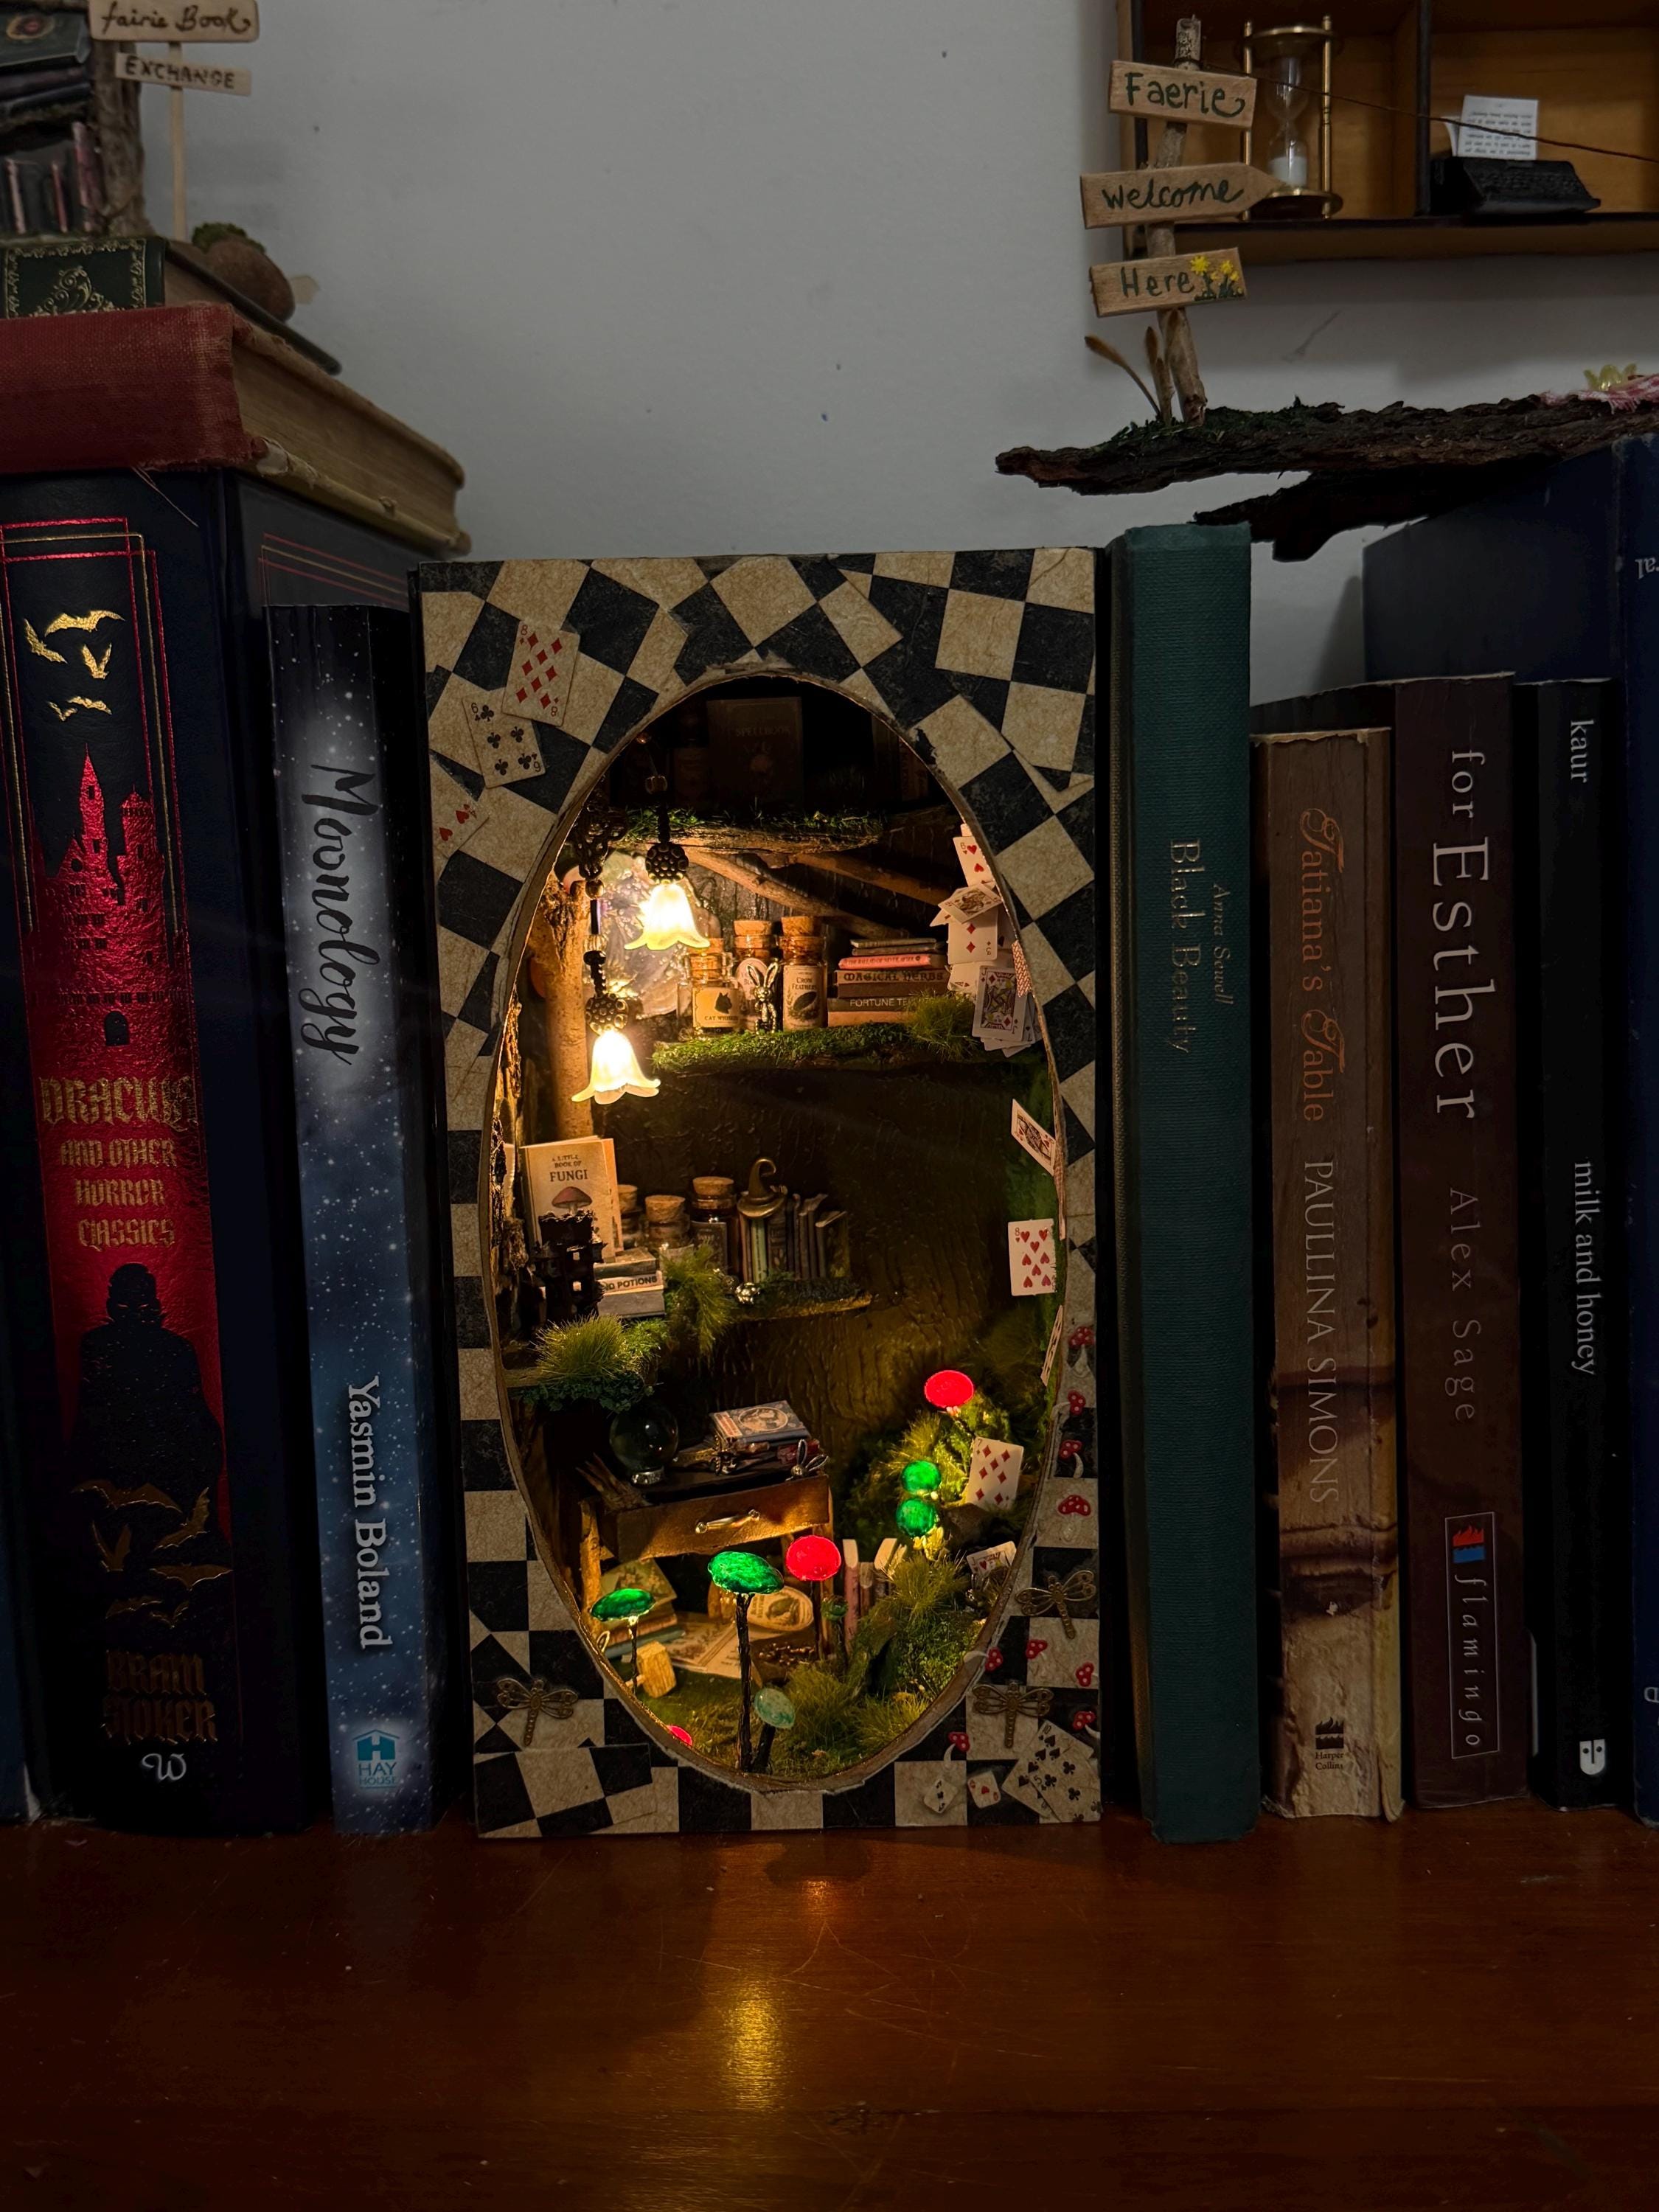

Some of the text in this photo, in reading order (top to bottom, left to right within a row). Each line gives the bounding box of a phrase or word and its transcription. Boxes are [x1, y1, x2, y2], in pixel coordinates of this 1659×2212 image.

[175, 4, 251, 34] Book
[125, 55, 236, 90] EXCHANGE
[1124, 72, 1246, 118] Faerie
[1120, 266, 1194, 298] Here
[1570, 719, 1595, 784] kaur
[298, 764, 380, 1066] Moonology
[1432, 749, 1498, 1120] for Esther
[1167, 838, 1206, 1054] Black Beauty
[1212, 883, 1235, 1005] Anna Sewell
[1298, 807, 1346, 1122] Tatiana's Table
[843, 972, 945, 982] MAGICAL HERBS
[849, 998, 895, 1008] FORTUNE
[108, 1138, 178, 1169] OTHER
[549, 1169, 588, 1182] FUNGI
[75, 1178, 166, 1208] HORROR
[77, 1218, 176, 1252] CLASSICS
[617, 1276, 658, 1289] POTIONS
[1571, 1161, 1604, 1376] milk and honey
[1444, 1186, 1482, 1422] Alex Sage
[1304, 1161, 1340, 1503] PAULLINA SIMONS
[348, 1374, 394, 1651] Yasmin Boland
[105, 1649, 208, 1697] BRAM
[1453, 1573, 1489, 1747] flamingo
[100, 1695, 220, 1746] STOKER
[358, 1761, 397, 1776] HAY
[1315, 1752, 1344, 1761] Harper
